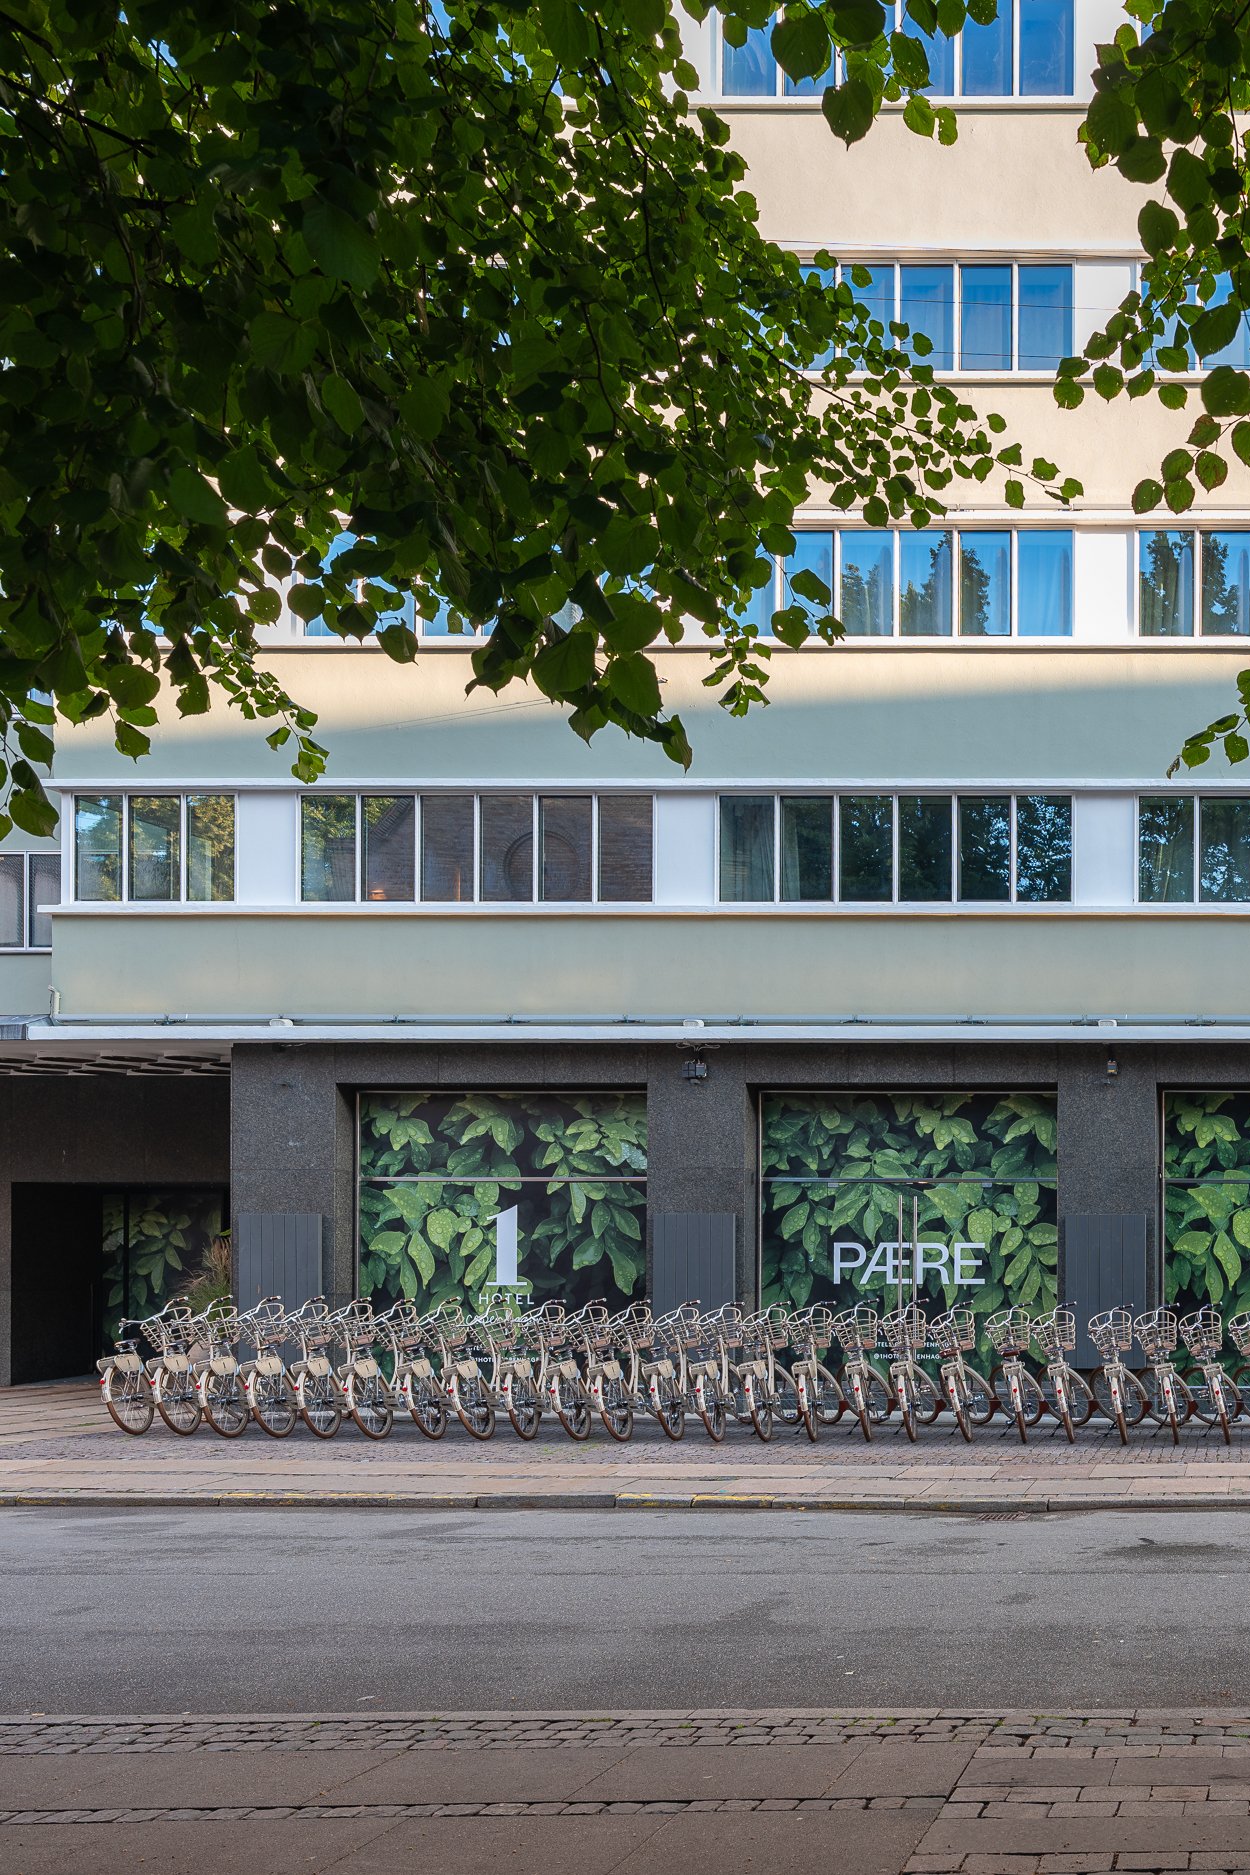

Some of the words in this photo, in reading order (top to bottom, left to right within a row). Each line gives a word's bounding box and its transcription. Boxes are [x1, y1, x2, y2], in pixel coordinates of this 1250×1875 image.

[486, 1204, 528, 1286] 1
[833, 1242, 986, 1285] PÆRE
[478, 1293, 535, 1305] HOTEL
